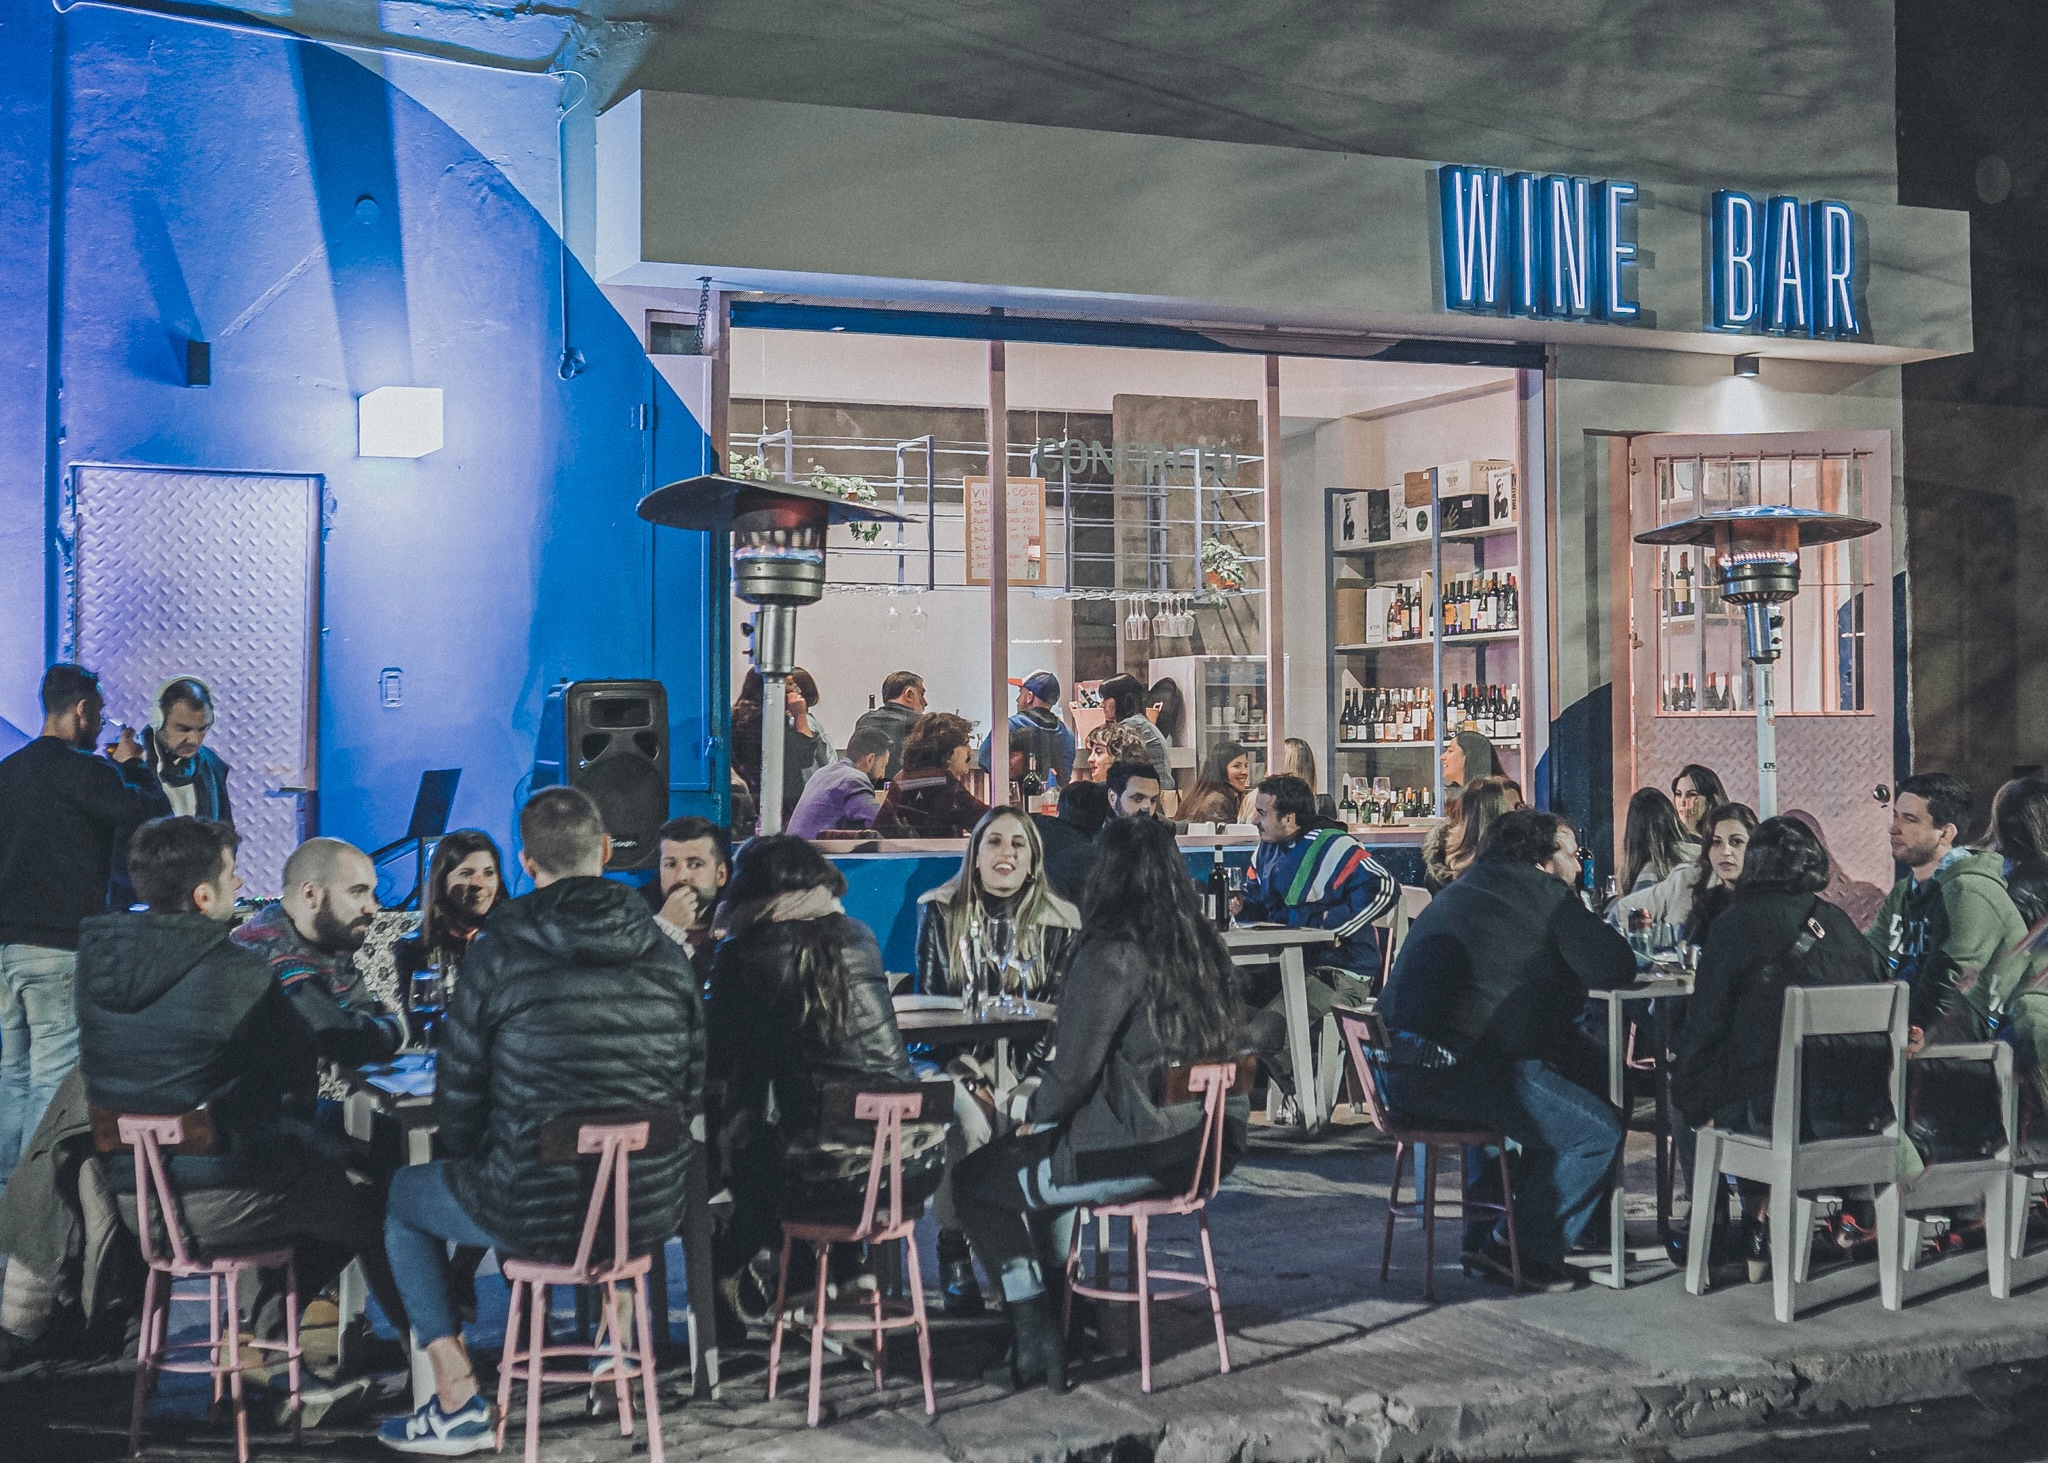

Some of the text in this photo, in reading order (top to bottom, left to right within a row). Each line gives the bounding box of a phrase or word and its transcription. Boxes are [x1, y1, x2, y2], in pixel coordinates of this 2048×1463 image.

[1441, 165, 1859, 336] WINE BAR
[1036, 437, 1238, 482] CONCRETO
